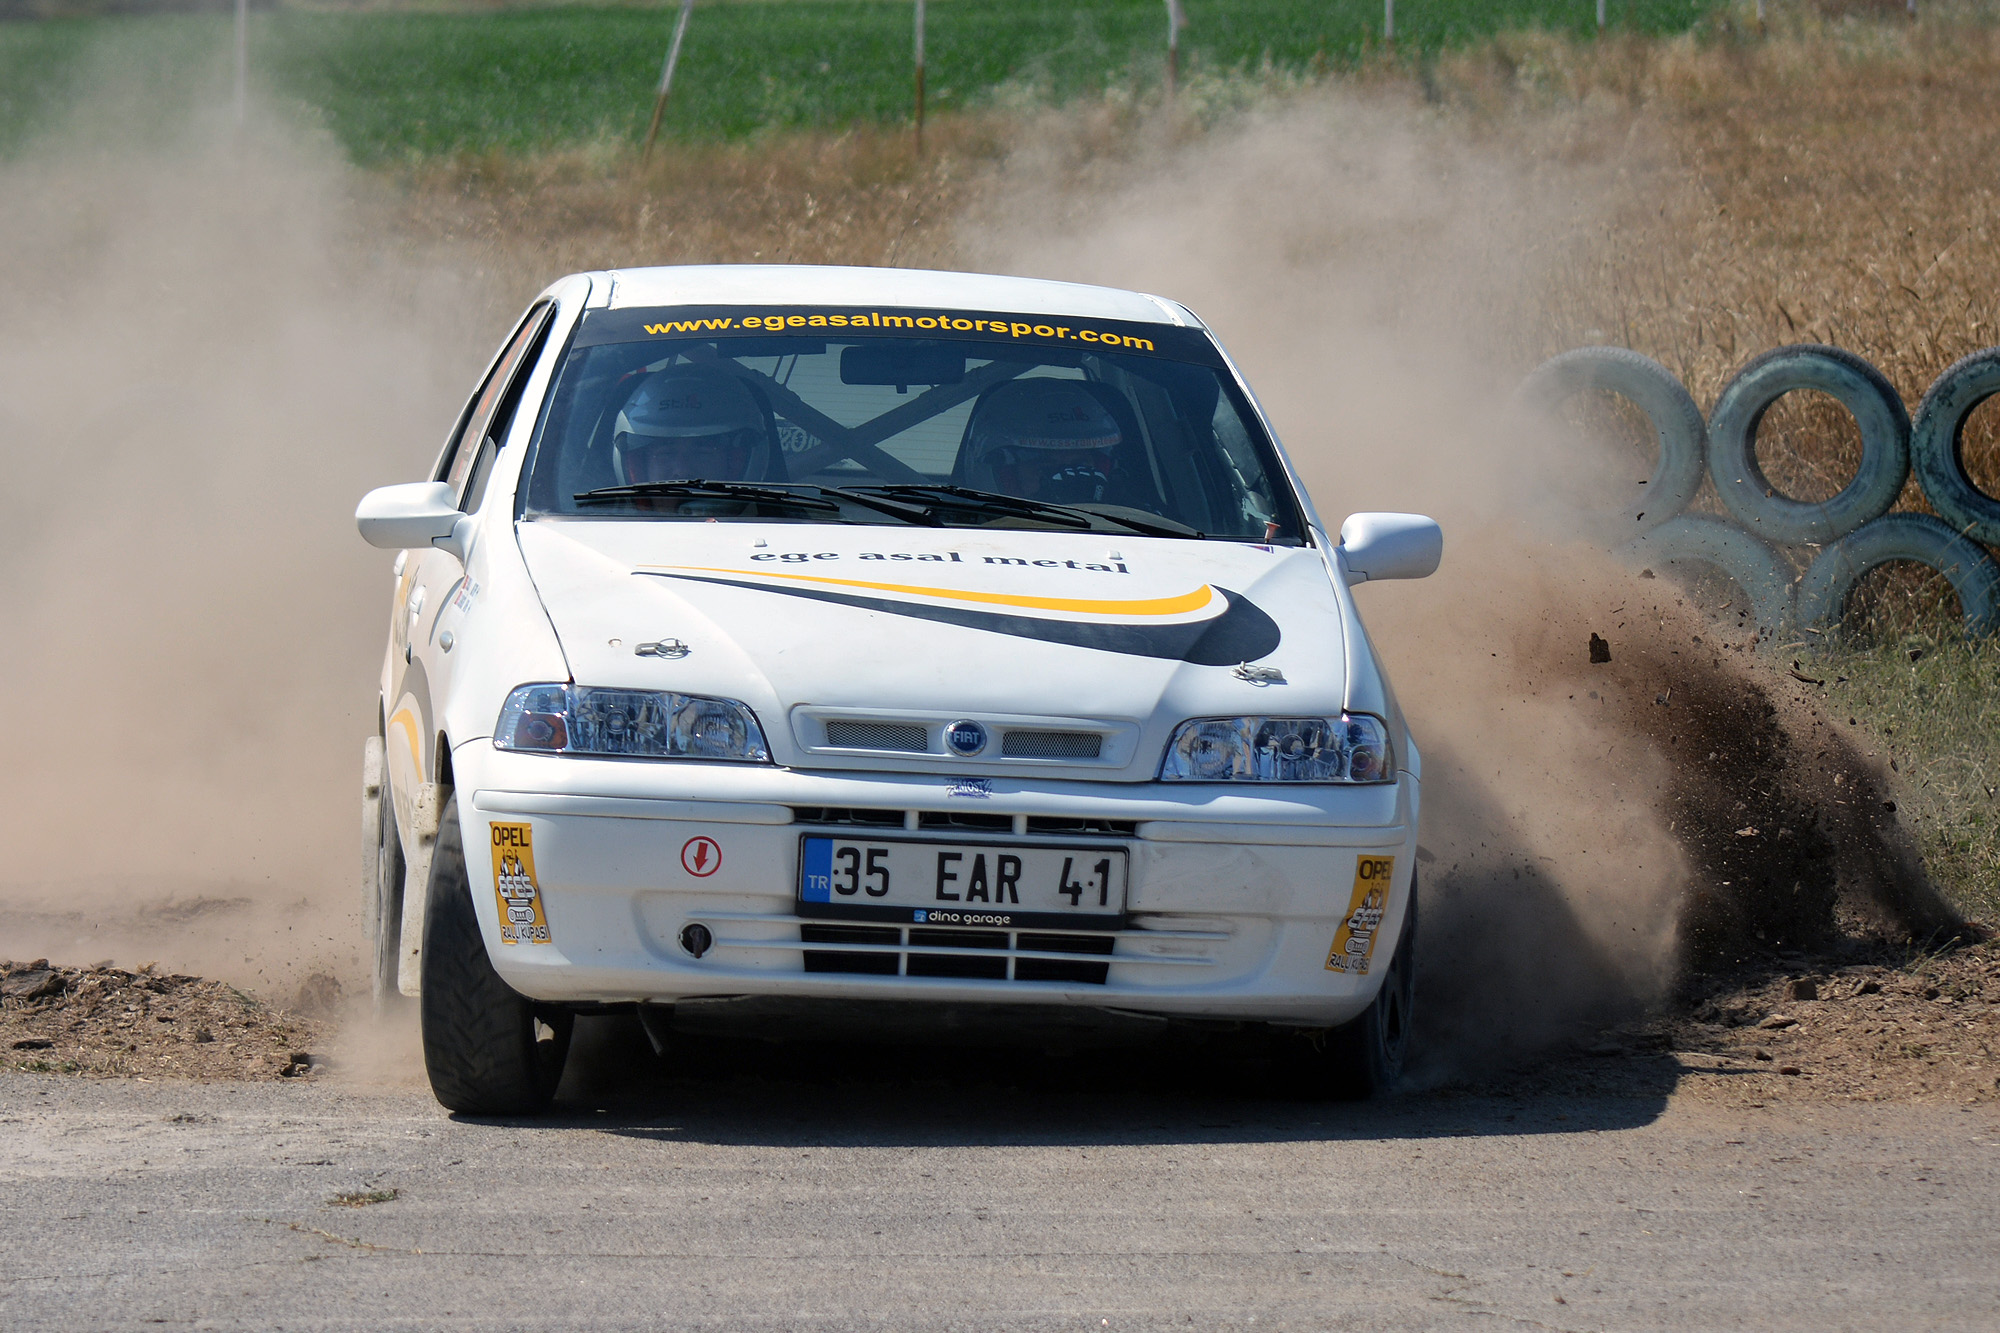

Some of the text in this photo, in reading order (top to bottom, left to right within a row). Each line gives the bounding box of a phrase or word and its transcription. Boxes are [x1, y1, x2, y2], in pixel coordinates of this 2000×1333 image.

[643, 312, 1154, 351] www.egeasalmotorspor.com
[749, 551, 1131, 575] ege asal metal
[953, 731, 980, 745] FIAT
[492, 826, 530, 847] OPEL
[834, 846, 1111, 906] 35 EAR 41
[1359, 860, 1391, 880] OPEL
[498, 875, 536, 899] EFES
[808, 874, 829, 890] TR
[928, 910, 1011, 926] dino garage
